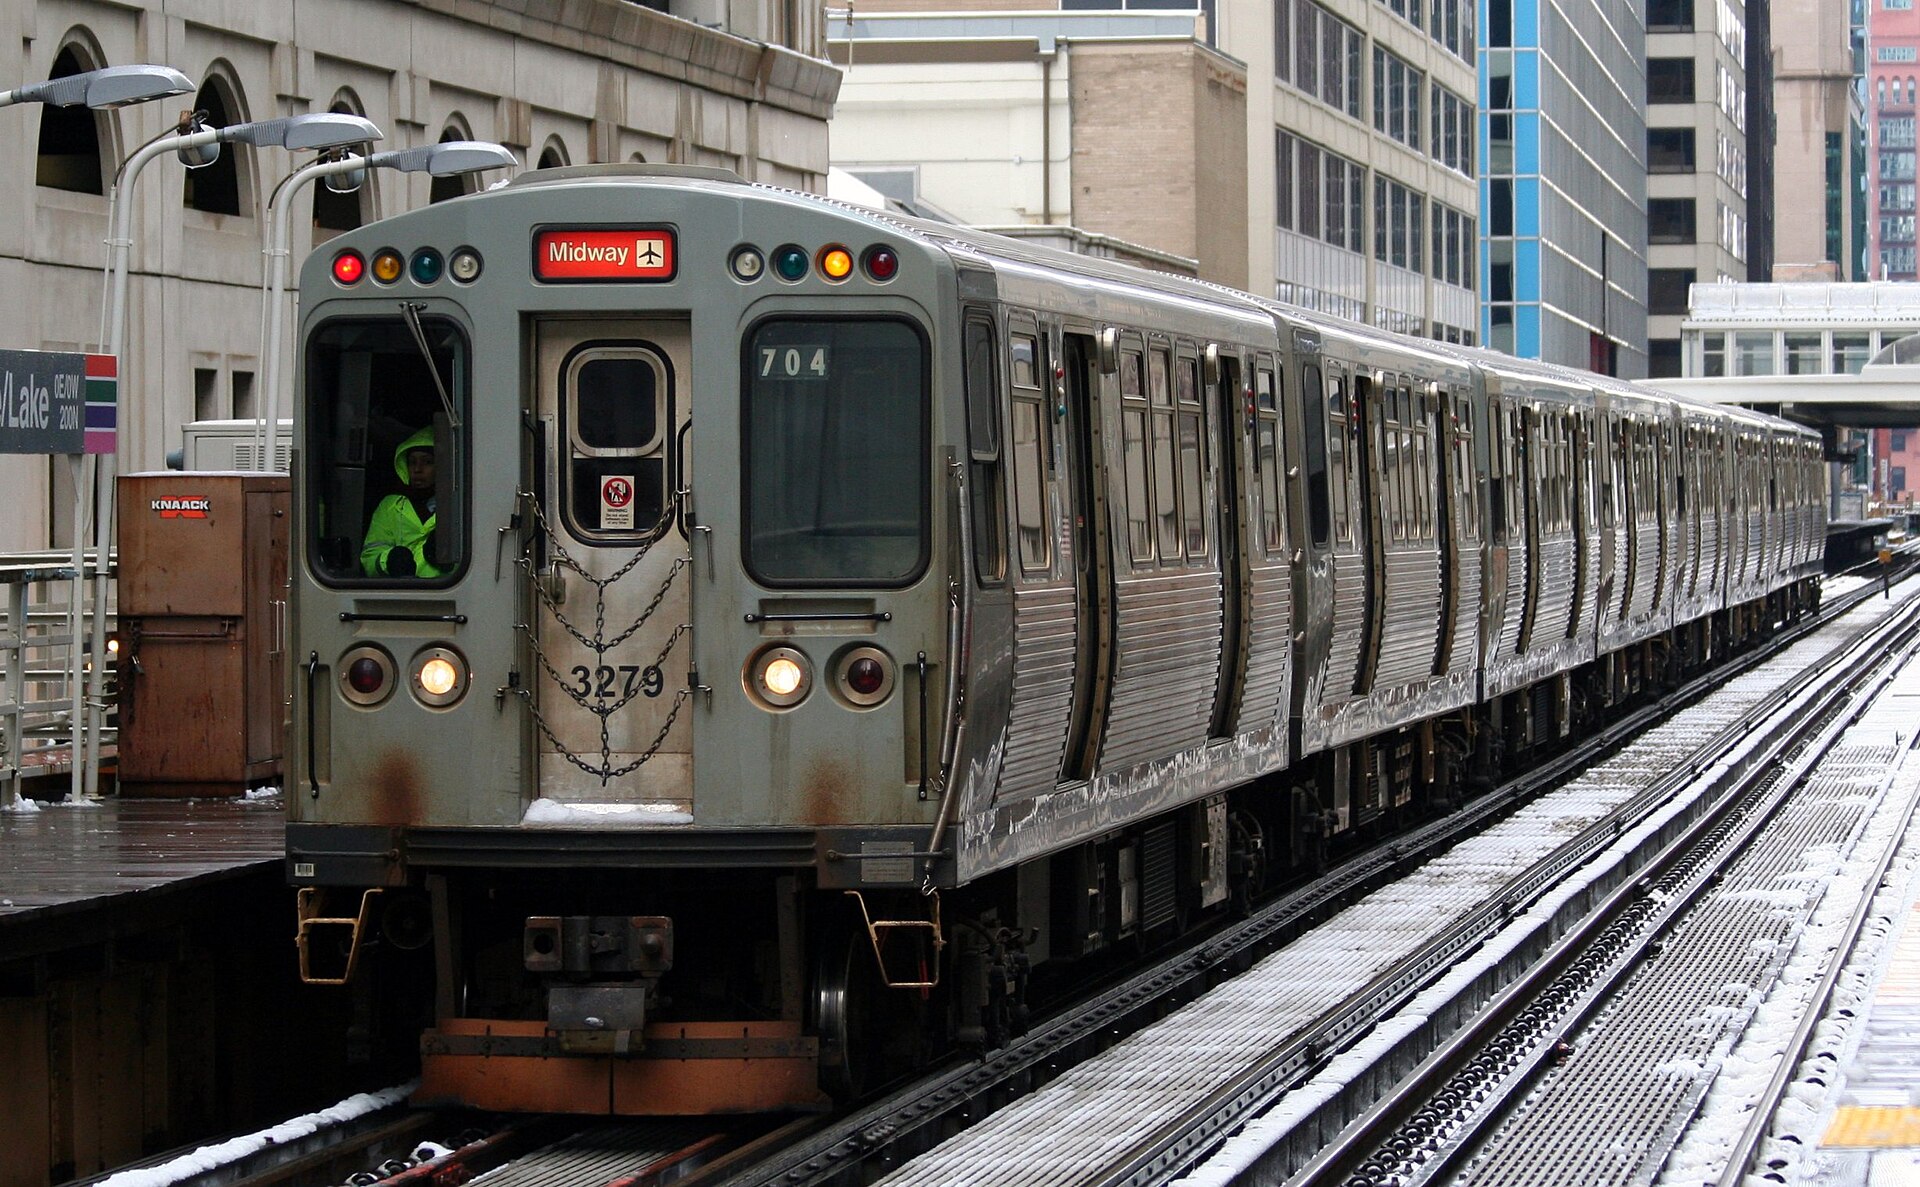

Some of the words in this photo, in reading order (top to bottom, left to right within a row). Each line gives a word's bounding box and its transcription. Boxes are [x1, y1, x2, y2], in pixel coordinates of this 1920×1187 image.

[549, 241, 629, 266] Midway
[761, 348, 826, 377] 704
[0, 370, 50, 430] /Lake
[59, 405, 79, 430] 200N
[151, 500, 210, 511] KNAACK
[571, 665, 664, 698] 3279
